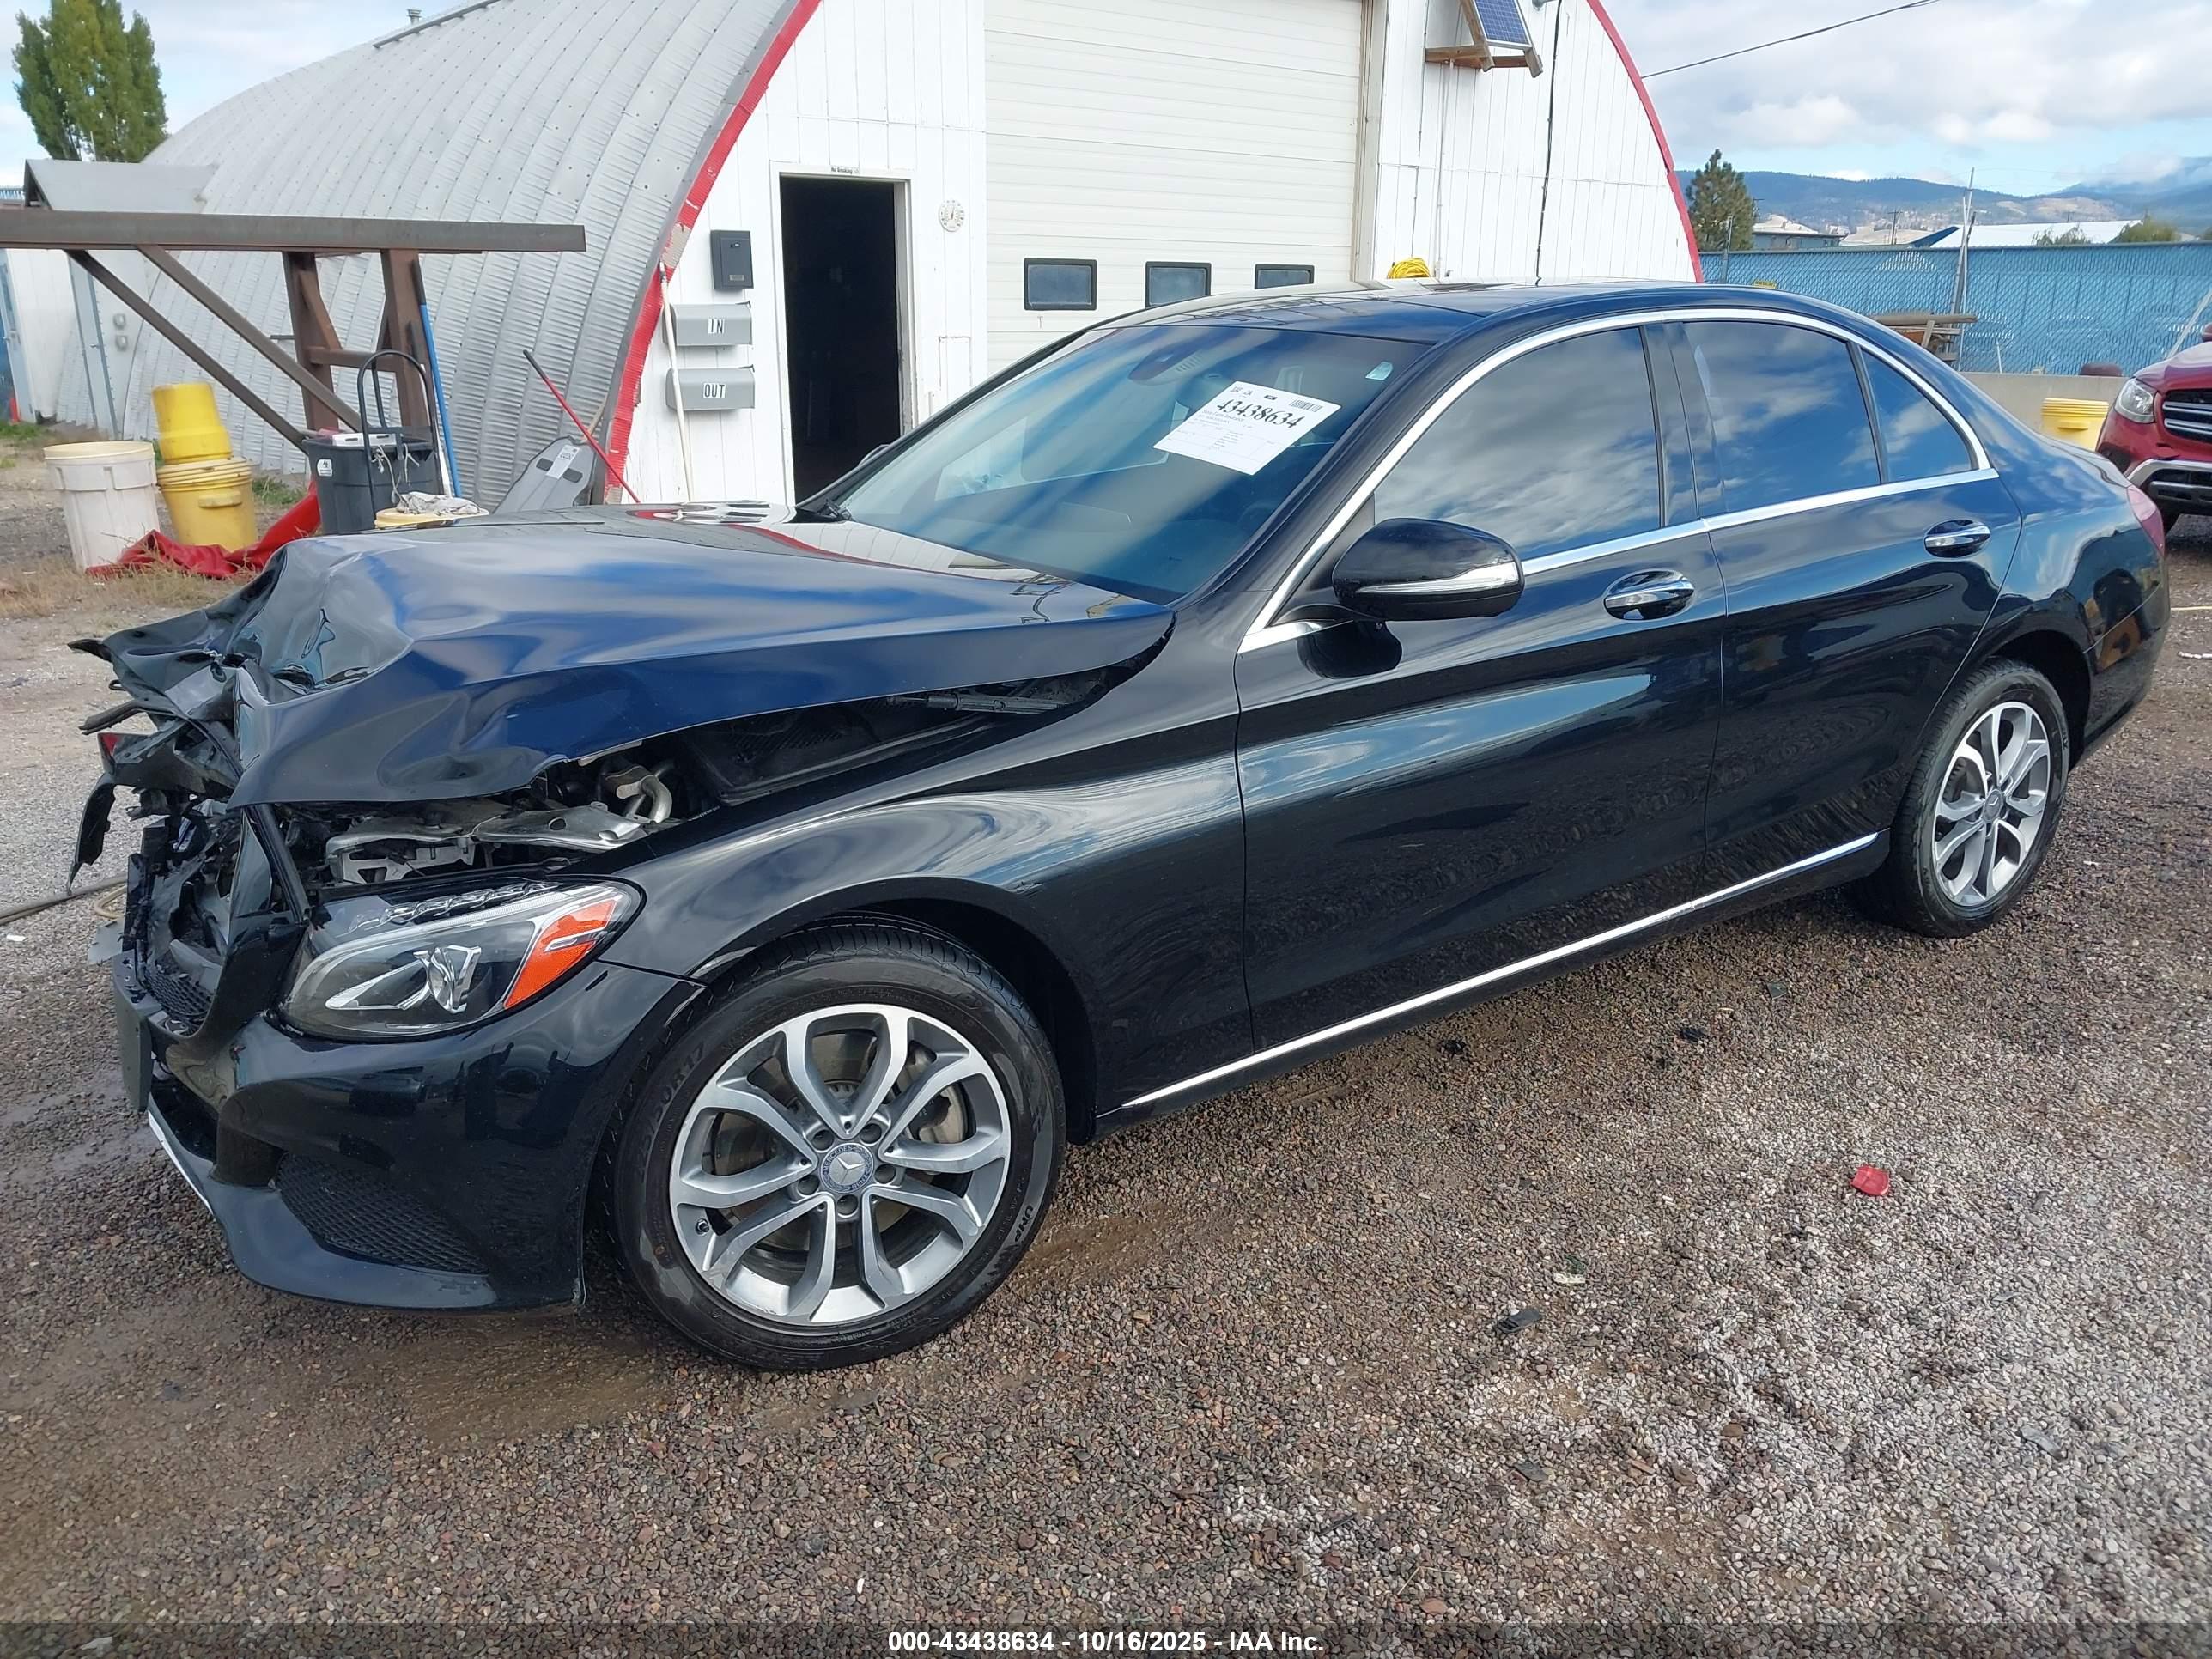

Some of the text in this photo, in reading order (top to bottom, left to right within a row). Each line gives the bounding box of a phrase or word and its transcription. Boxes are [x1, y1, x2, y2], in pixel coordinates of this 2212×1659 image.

[710, 318, 725, 334] IN
[703, 383, 726, 398] OUT
[1216, 398, 1306, 429] 43438634
